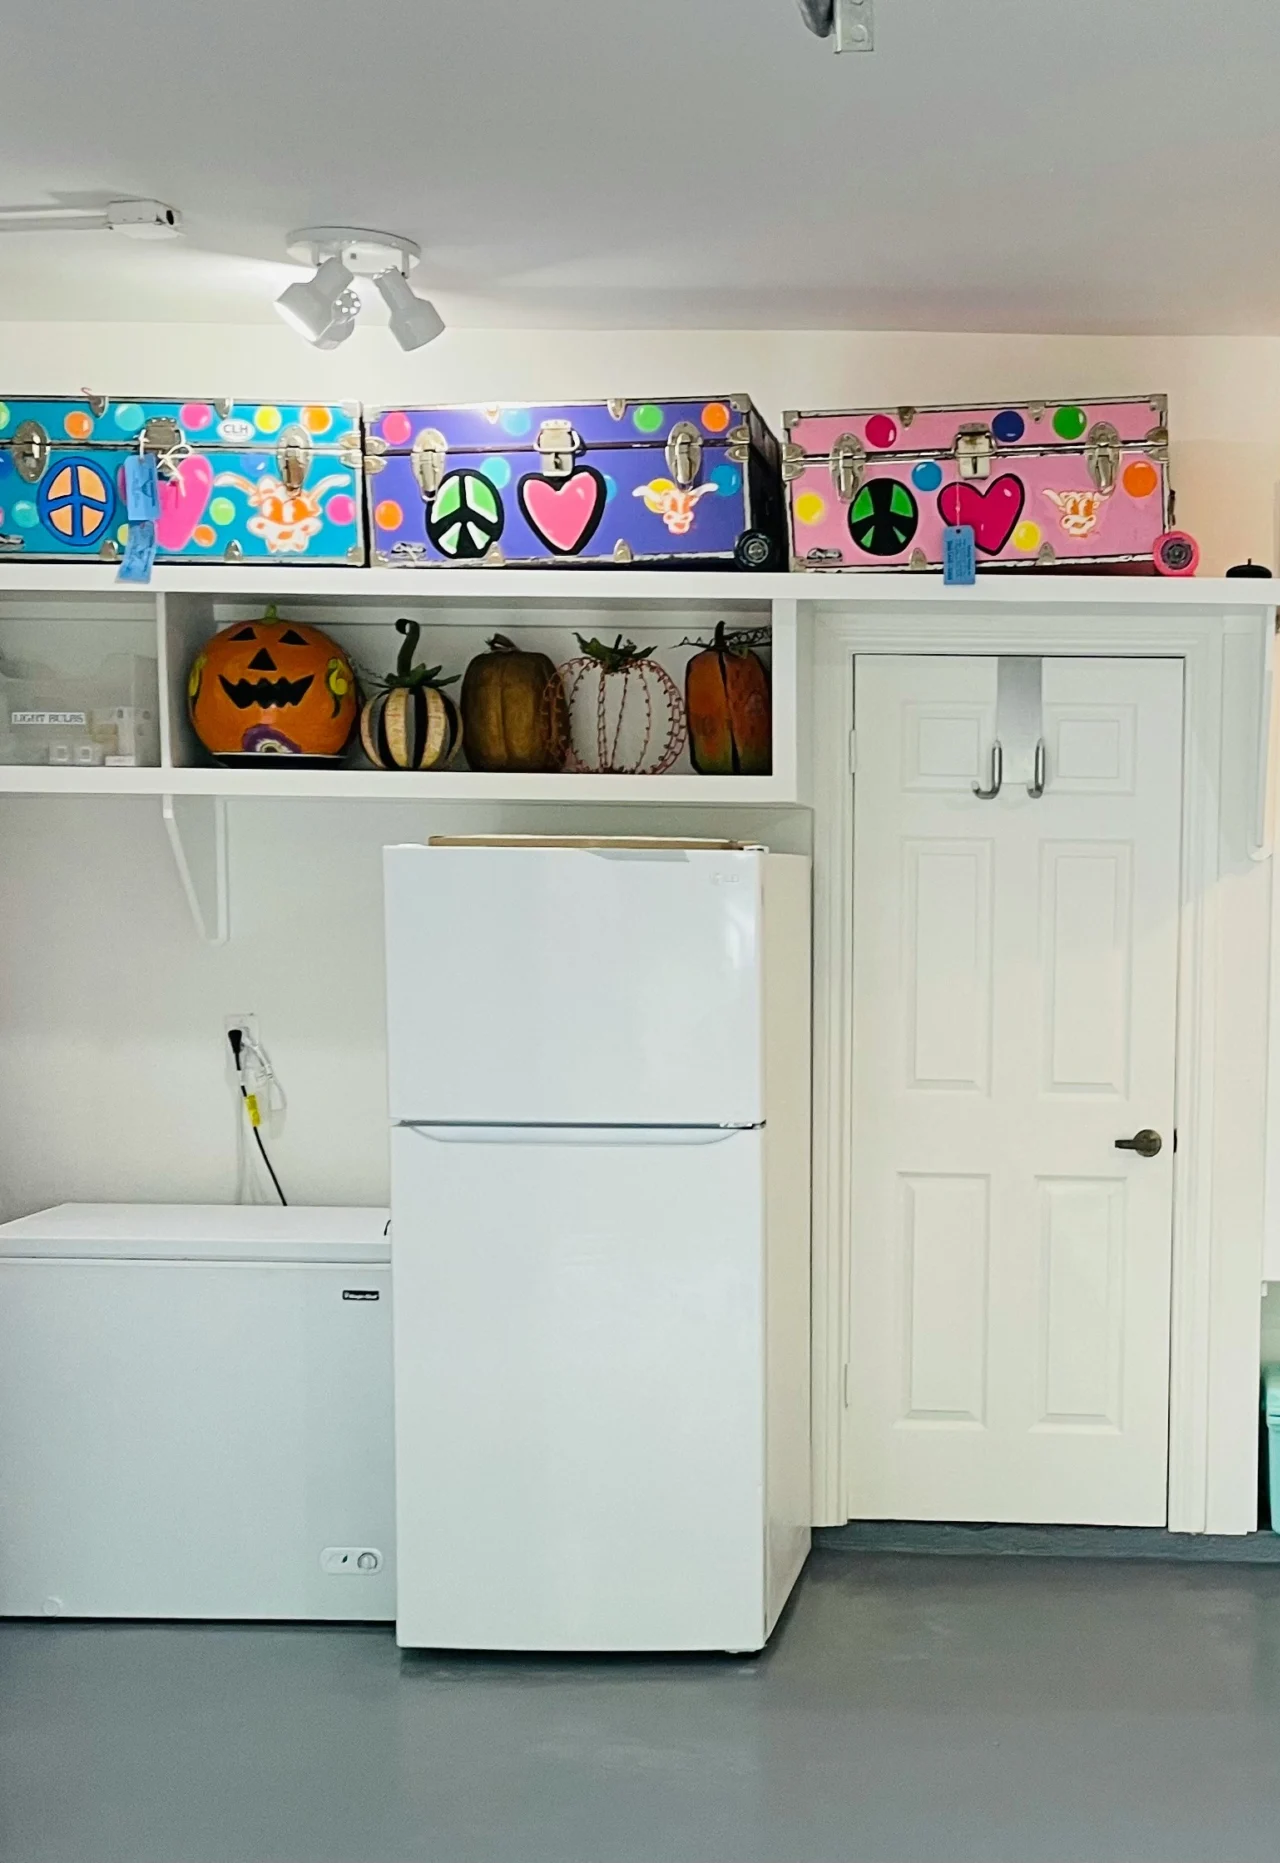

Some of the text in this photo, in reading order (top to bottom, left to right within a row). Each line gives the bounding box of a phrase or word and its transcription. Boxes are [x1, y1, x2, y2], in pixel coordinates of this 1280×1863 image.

[223, 424, 248, 434] CLH
[14, 714, 83, 723] LIGHT BULBS
